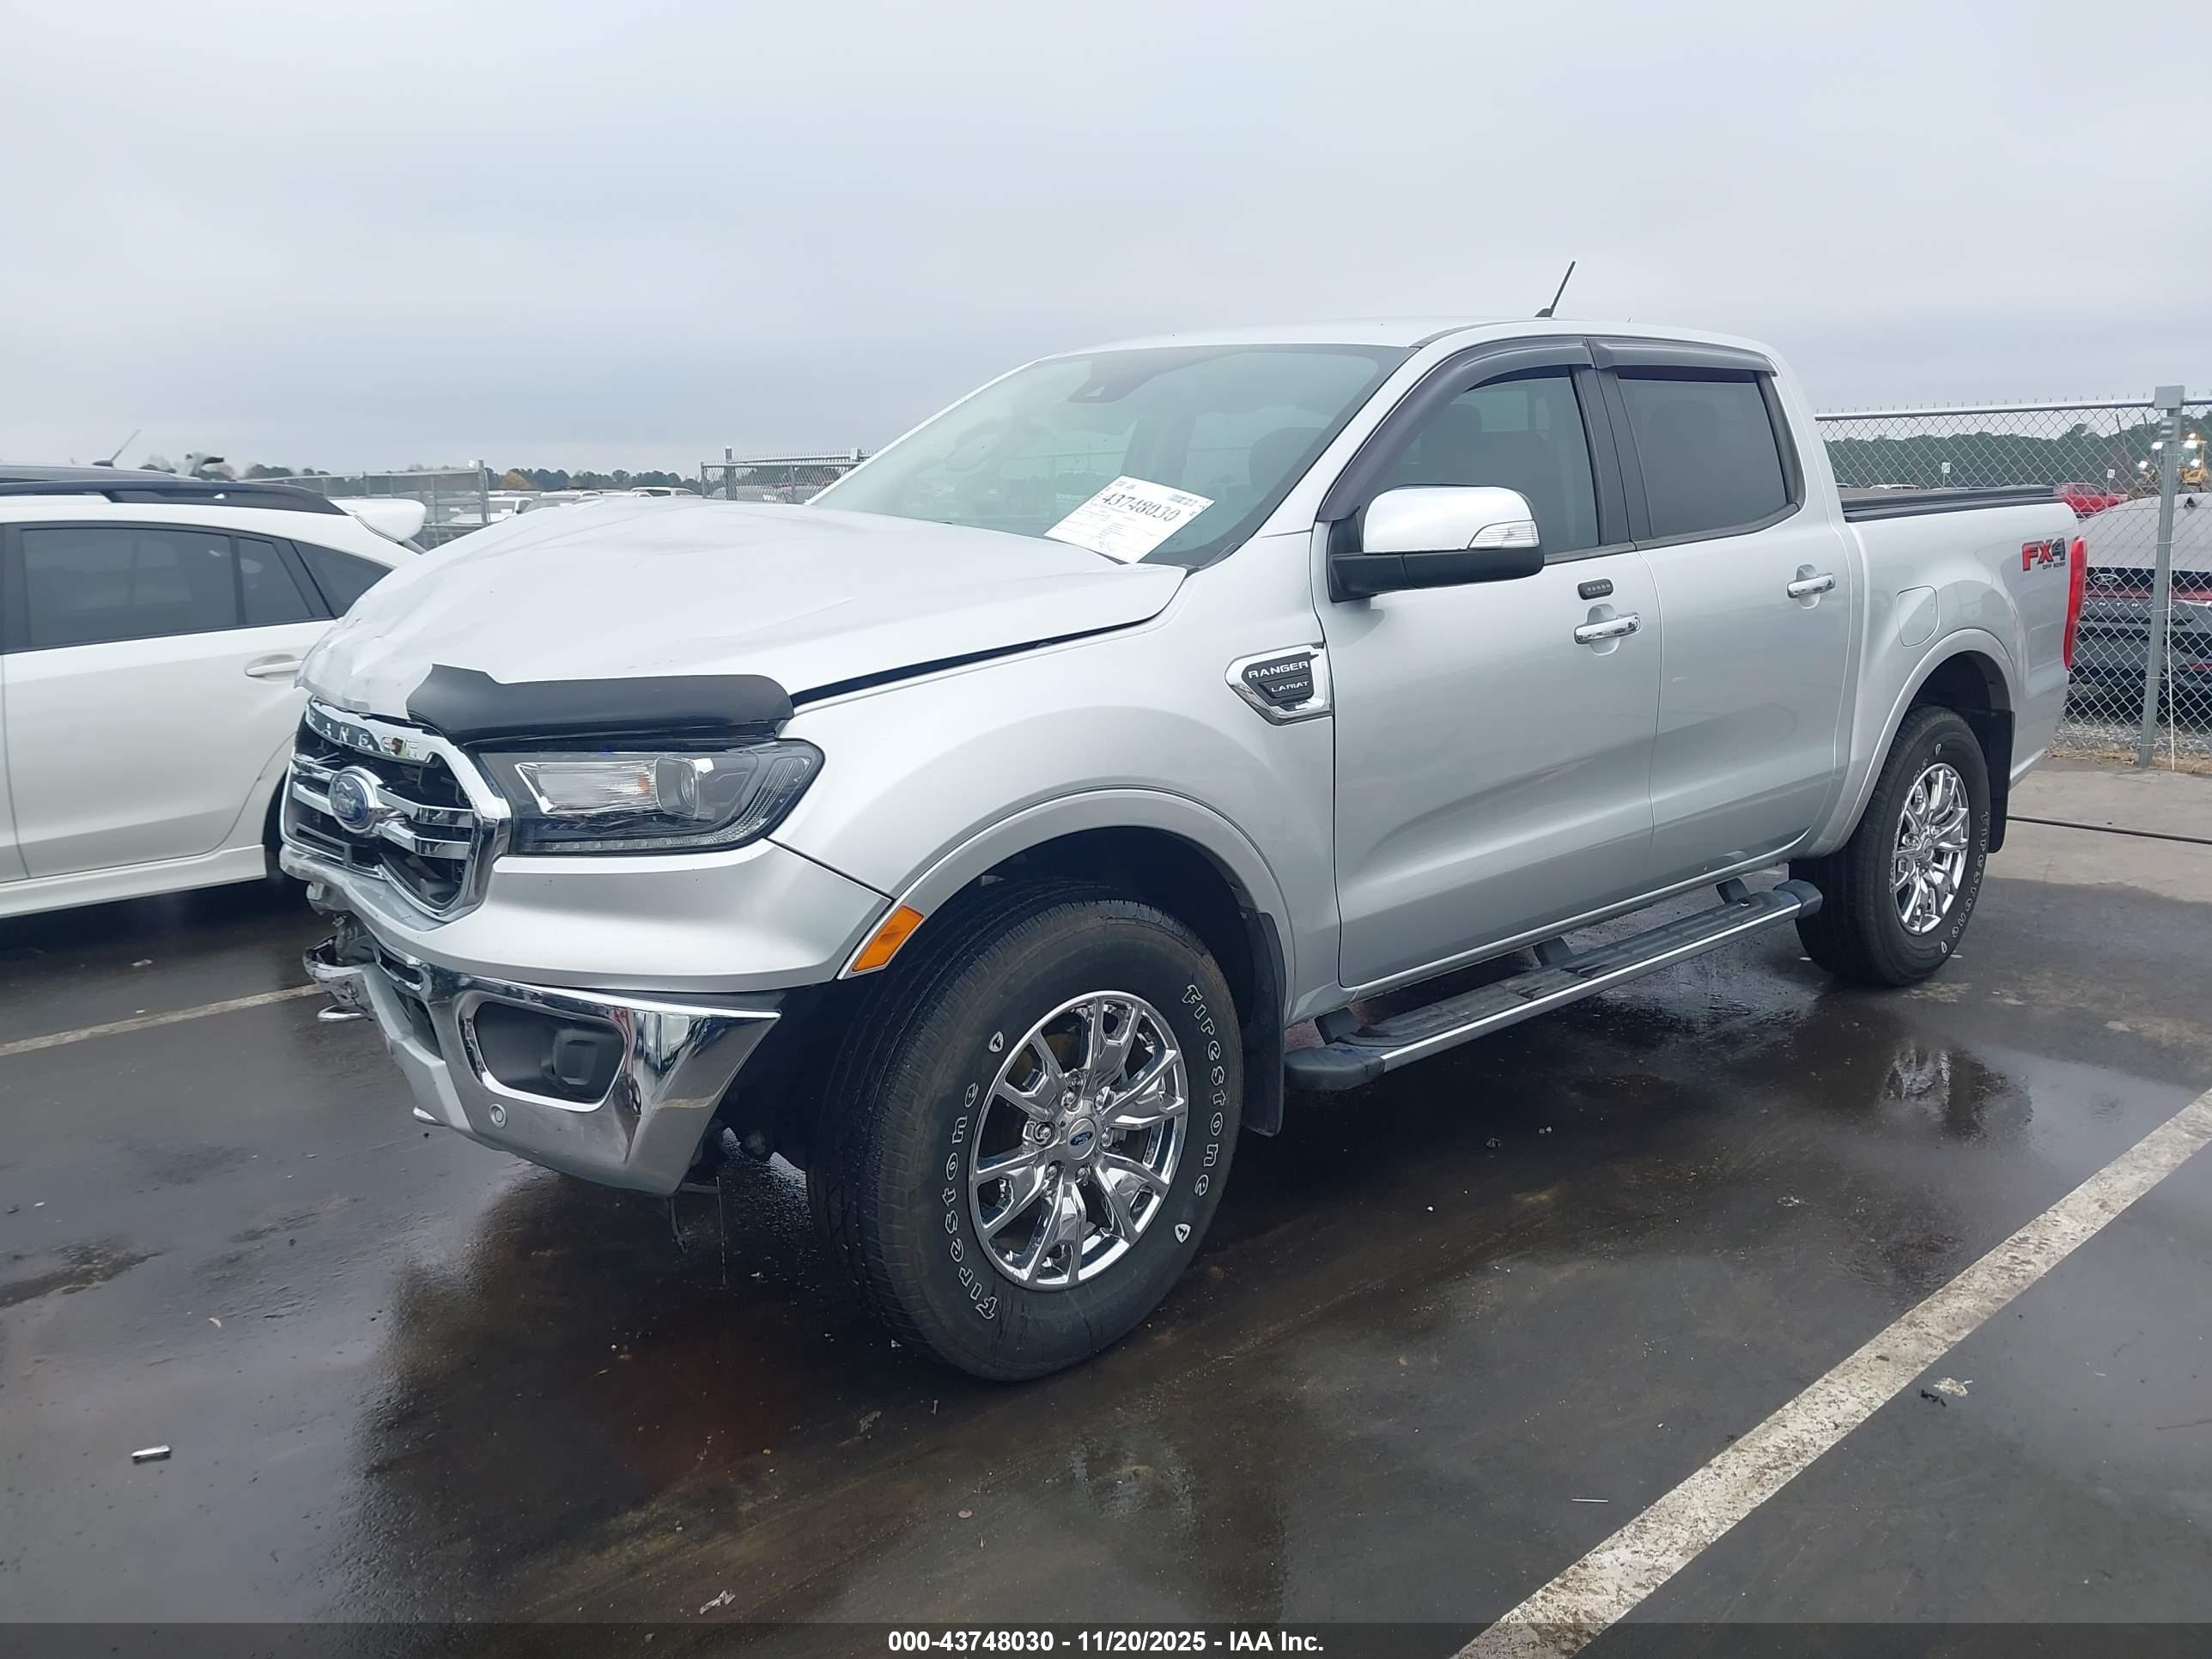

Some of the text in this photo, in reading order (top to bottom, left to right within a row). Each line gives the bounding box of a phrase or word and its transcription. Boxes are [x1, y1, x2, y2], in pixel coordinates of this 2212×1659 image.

[1103, 493, 1182, 522] 43748030
[2021, 538, 2066, 573] FX4
[1248, 660, 1310, 680] RANGER
[1271, 681, 1310, 693] LARIAT
[1181, 984, 1226, 1197] Firestone
[942, 1082, 998, 1319] Firestone
